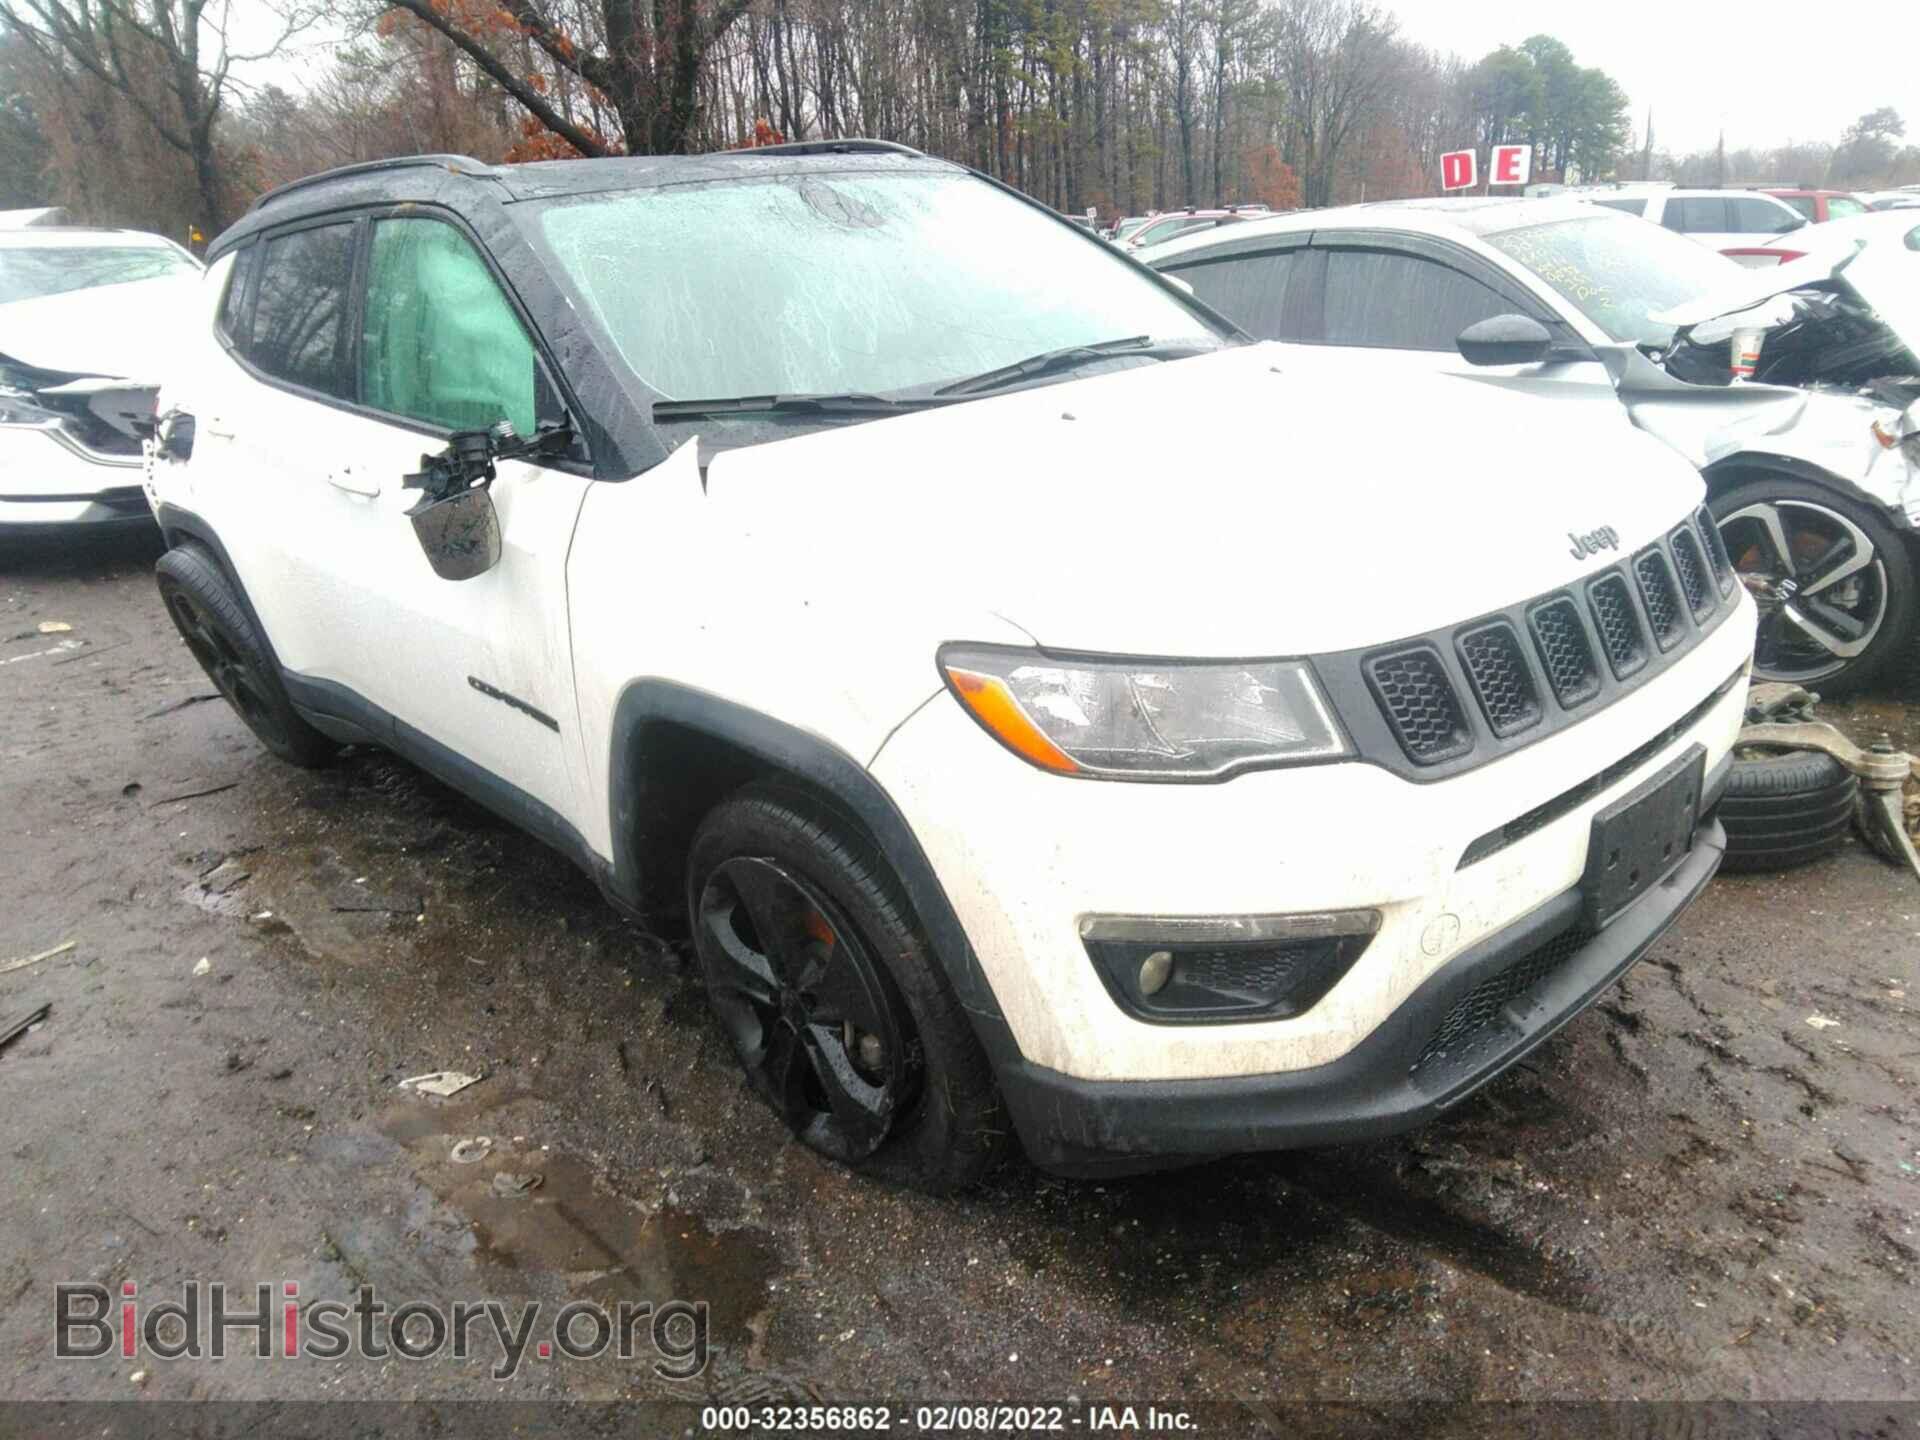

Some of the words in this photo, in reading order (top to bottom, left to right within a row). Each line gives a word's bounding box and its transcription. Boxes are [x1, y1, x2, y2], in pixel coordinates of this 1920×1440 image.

[1443, 153, 1473, 189] D
[1496, 148, 1523, 182] E
[1568, 525, 1619, 560] Jeep
